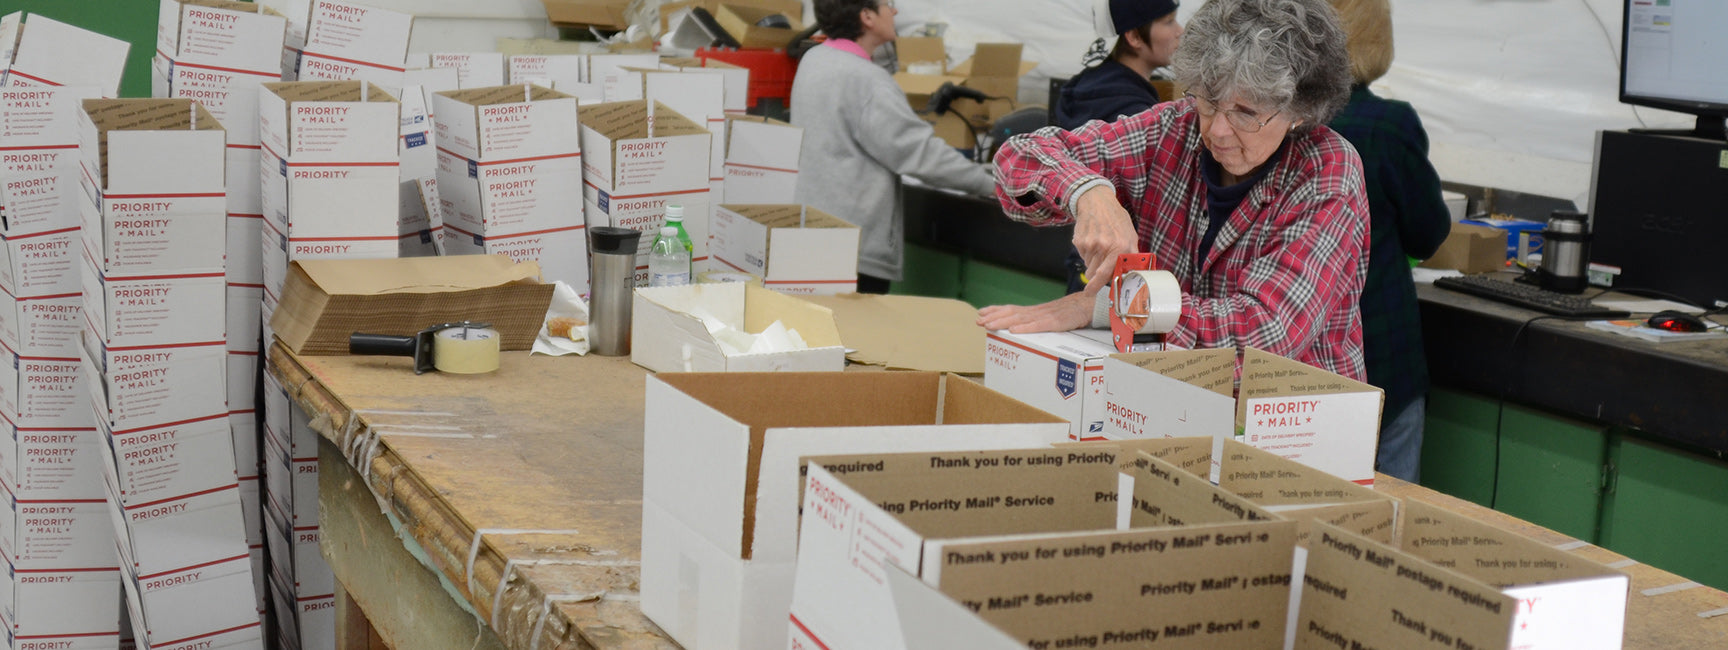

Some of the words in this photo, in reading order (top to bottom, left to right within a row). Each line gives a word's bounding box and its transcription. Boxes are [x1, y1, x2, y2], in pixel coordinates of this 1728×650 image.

[320, 1, 366, 17] PRIORITY
[189, 10, 238, 23] PRIORITY
[329, 12, 353, 23] MAIL
[200, 21, 225, 30] MAIL
[307, 60, 357, 75] PRIORITY
[180, 71, 231, 83] PRIORITY
[3, 91, 53, 100] PRIORITY
[179, 89, 228, 99] PRIORITY
[297, 107, 348, 115] PRIORITY
[484, 105, 531, 116] PRIORITY
[495, 115, 520, 123] MAIL
[621, 142, 667, 151] PRIORITY
[4, 153, 57, 163] PRIORITY
[17, 164, 45, 172] MAIL
[485, 165, 535, 177] PRIORITY
[295, 171, 348, 179] PRIORITY
[8, 177, 57, 190] PRIORITY
[490, 180, 535, 191] PRIORITY
[20, 187, 46, 197] MAIL
[501, 190, 525, 198] MAIL
[112, 203, 170, 212] PRIORITY
[617, 200, 665, 211] PRIORITY
[114, 220, 169, 229] PRIORITY
[620, 214, 665, 226] PRIORITY
[127, 229, 156, 237] MAIL
[20, 241, 70, 252] PRIORITY
[296, 245, 348, 254] PRIORITY
[33, 251, 59, 259] MAIL
[115, 288, 169, 298] PRIORITY
[32, 304, 81, 313] PRIORITY
[988, 343, 1020, 362] PRIORITY
[114, 353, 170, 364] PRIORITY
[26, 364, 78, 373] PRIORITY
[114, 368, 167, 383] PRIORITY
[39, 384, 65, 392] MAIL
[128, 380, 156, 390] MAIL
[1106, 401, 1147, 425] PRIORITY
[1253, 401, 1318, 416] PRIORITY
[1116, 418, 1137, 434] MAIL
[1268, 416, 1302, 428] MAIL
[24, 435, 75, 443] PRIORITY
[120, 430, 176, 447] PRIORITY
[125, 443, 176, 461] PRIORITY
[138, 456, 166, 466] MAIL
[930, 456, 970, 468] Thank
[974, 456, 999, 469] you
[1004, 455, 1022, 466] for
[1027, 454, 1063, 467] using
[1068, 452, 1116, 465] Priority
[810, 476, 851, 517] PRIORITY
[909, 498, 961, 511] Priority
[1004, 495, 1054, 507] Service
[132, 502, 187, 521] PRIORITY
[26, 518, 74, 526] PRIORITY
[947, 551, 995, 565] Thank
[1000, 550, 1029, 565] you
[1035, 547, 1056, 559] for
[1063, 544, 1105, 558] using
[1110, 540, 1167, 554] Priority
[1322, 532, 1362, 560] Priority
[1397, 565, 1444, 591] postage
[1447, 584, 1501, 614] required
[146, 572, 200, 590] PRIORITY
[1034, 591, 1093, 606] Service
[1141, 582, 1195, 596] Priority
[1391, 608, 1427, 635] Thank
[1429, 629, 1453, 646] you
[1056, 634, 1097, 648] using
[1103, 629, 1159, 644] Priority
